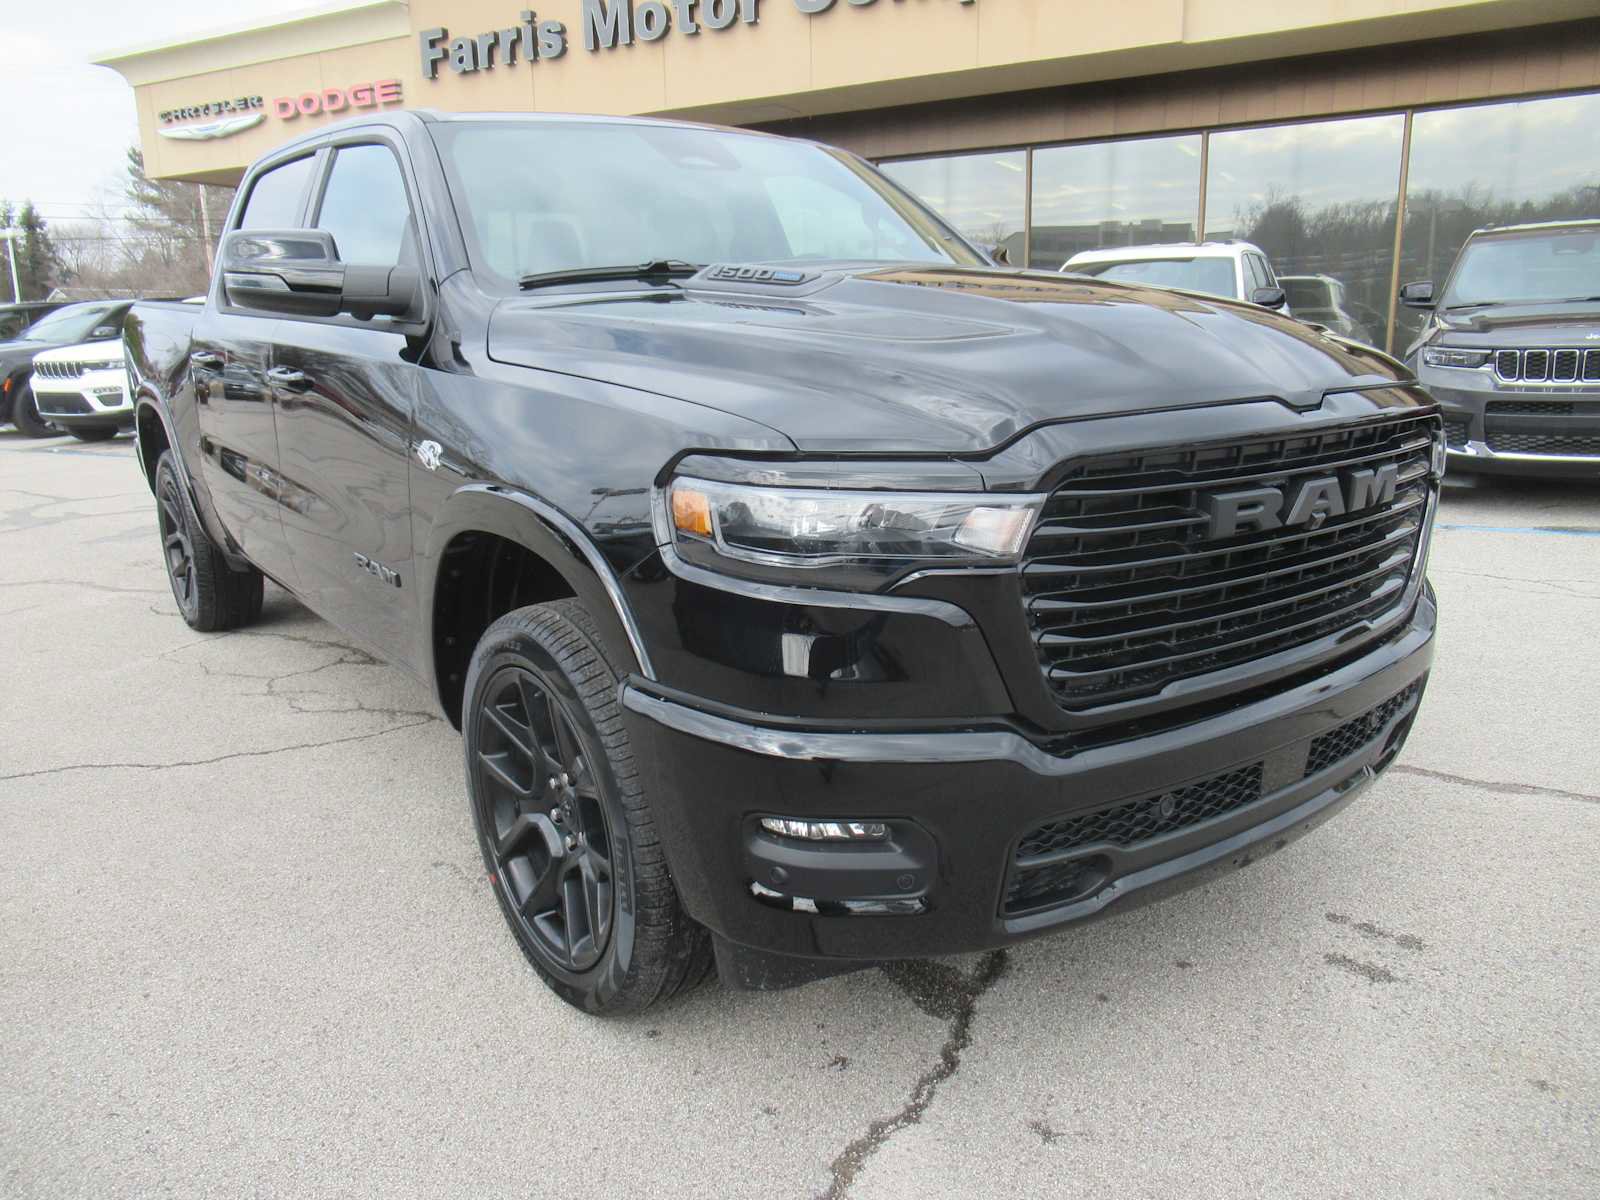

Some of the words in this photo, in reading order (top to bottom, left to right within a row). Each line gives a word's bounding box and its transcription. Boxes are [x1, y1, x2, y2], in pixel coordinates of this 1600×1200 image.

[418, 11, 567, 79] Farris
[581, 0, 759, 52] Motor
[273, 79, 403, 121] DODGE
[711, 264, 775, 282] 1500
[1209, 463, 1398, 538] RAM
